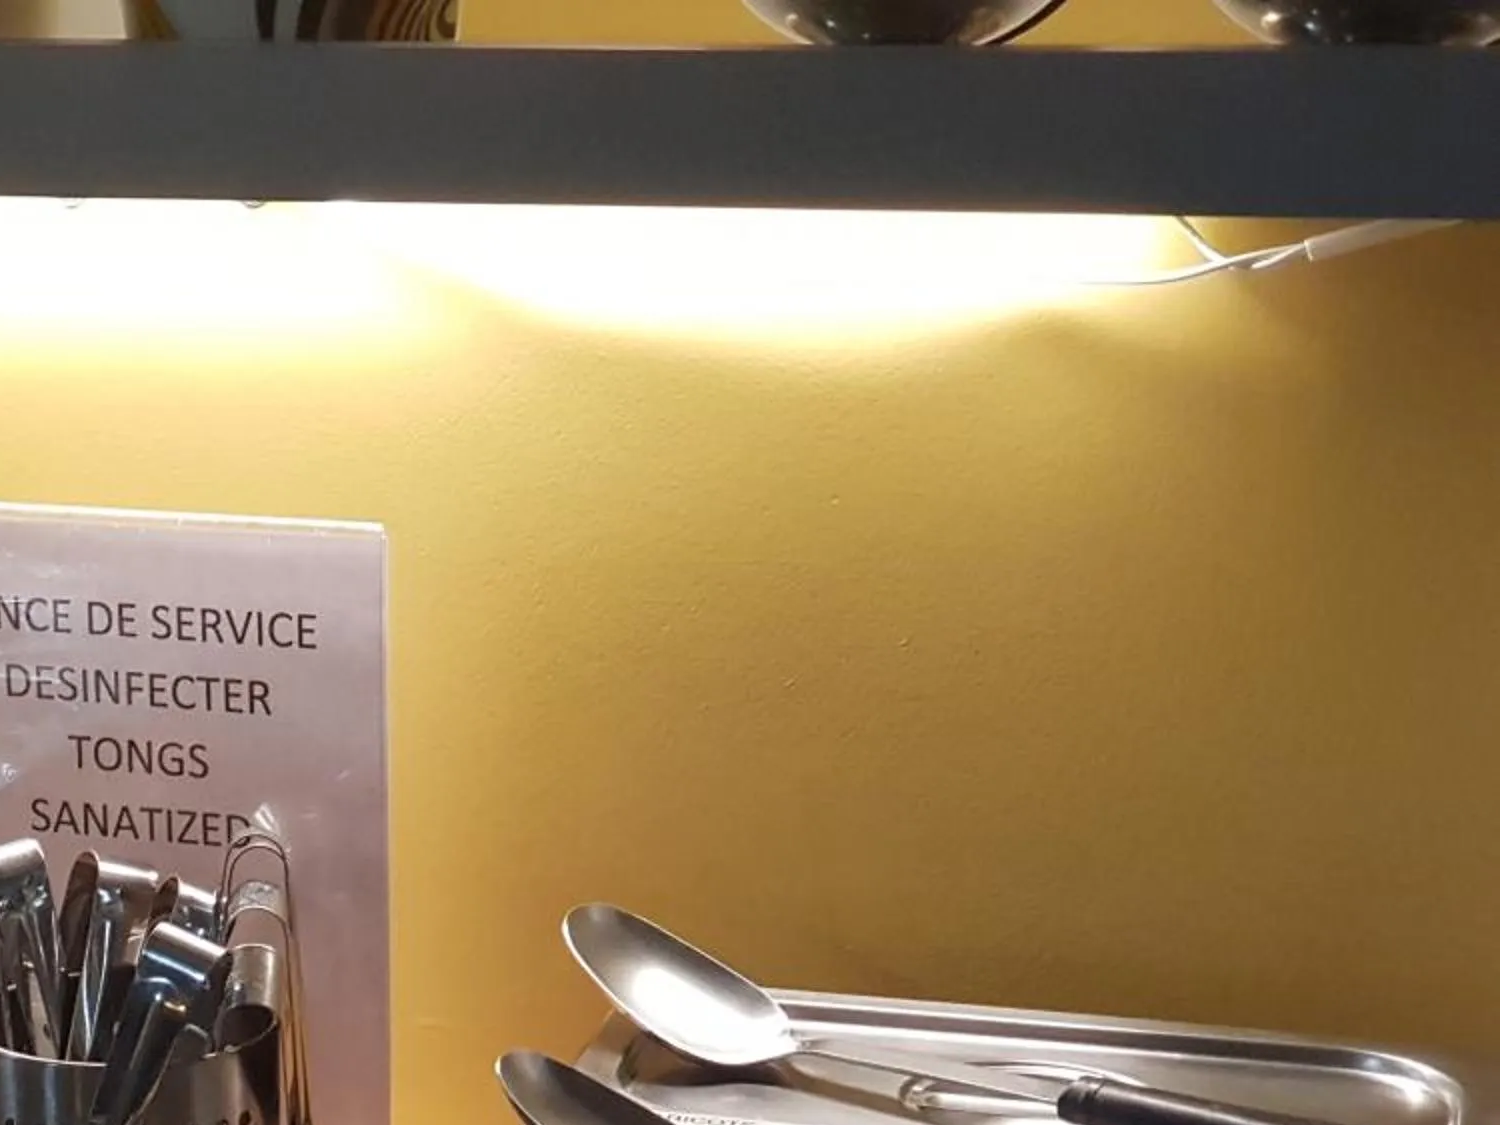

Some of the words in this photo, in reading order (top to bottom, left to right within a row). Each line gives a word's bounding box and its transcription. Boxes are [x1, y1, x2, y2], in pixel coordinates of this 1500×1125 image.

[87, 601, 138, 637] DE
[151, 605, 318, 650] SERVICE
[6, 663, 272, 716] DESINFECTER
[68, 734, 210, 779] TONGS
[31, 797, 251, 848] SANATIZED
